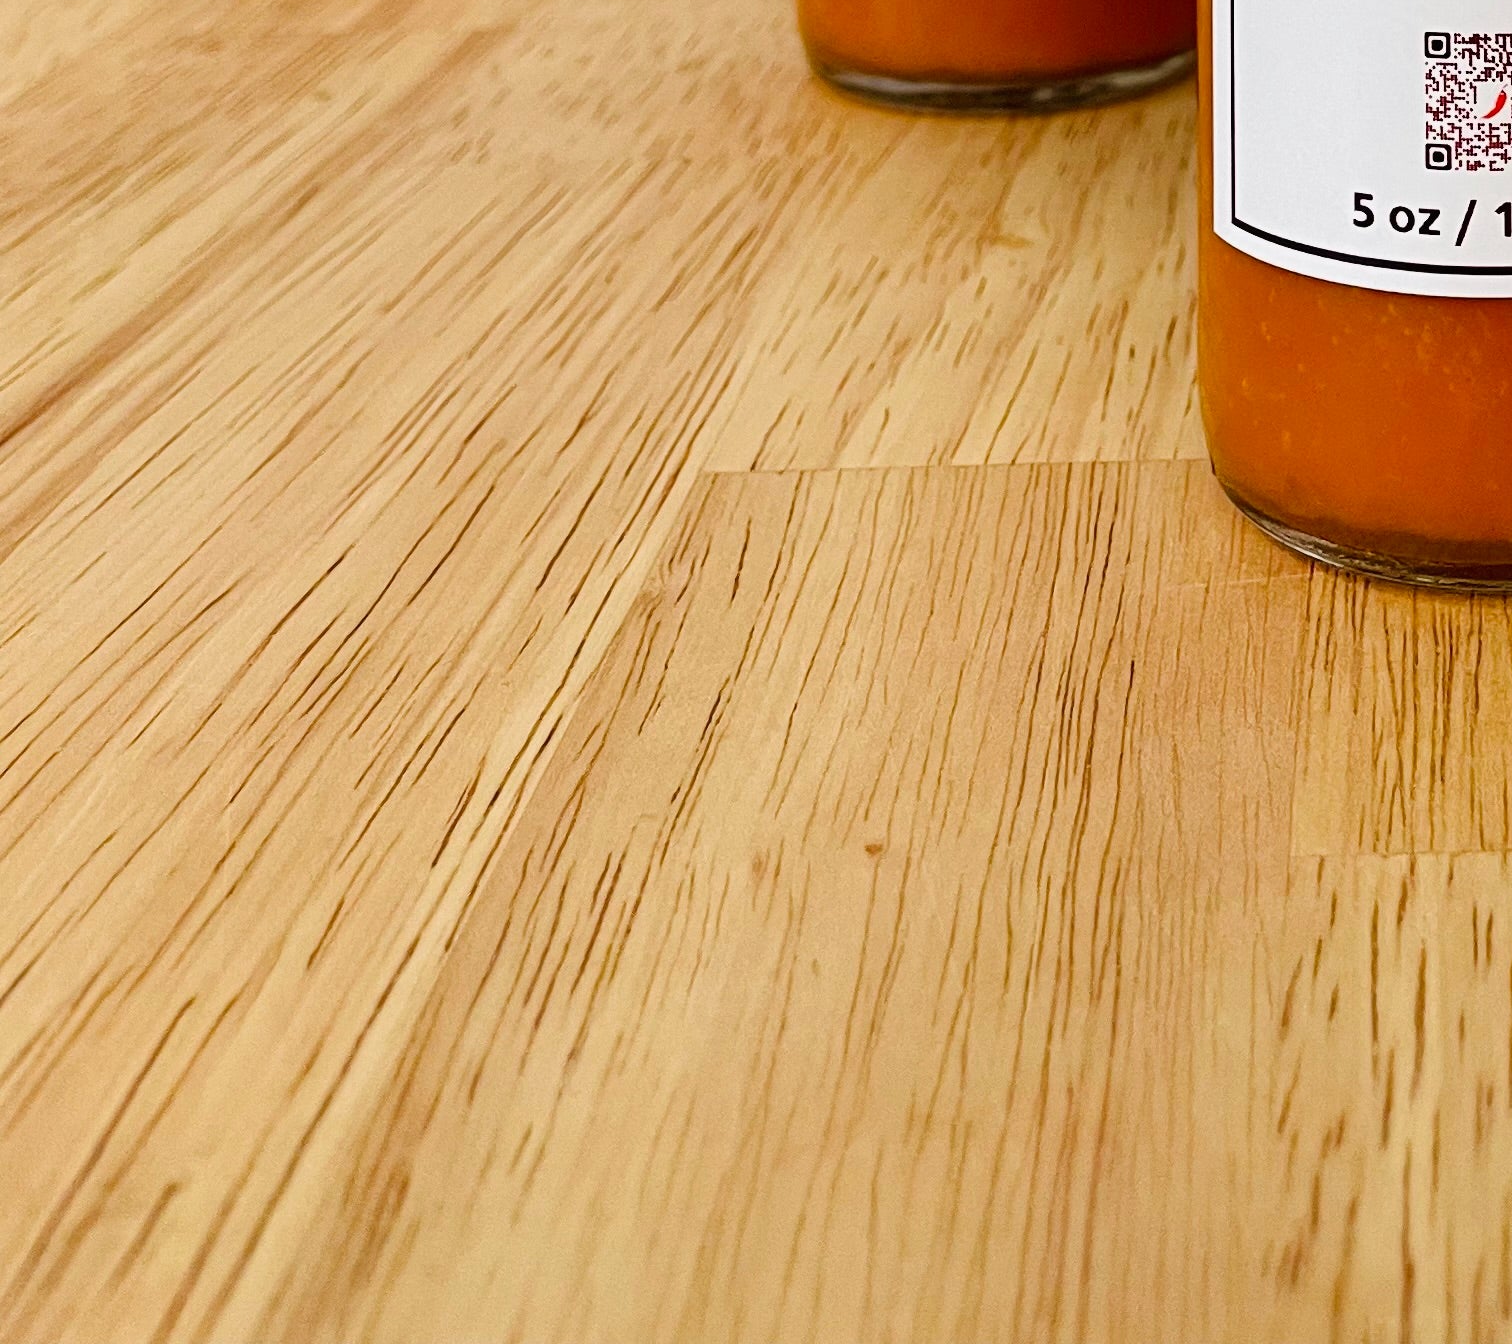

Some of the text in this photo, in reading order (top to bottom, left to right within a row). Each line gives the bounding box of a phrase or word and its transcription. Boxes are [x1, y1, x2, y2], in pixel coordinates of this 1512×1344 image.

[1353, 192, 1374, 228] 5
[1389, 206, 1440, 235] oz
[1455, 200, 1477, 246] /
